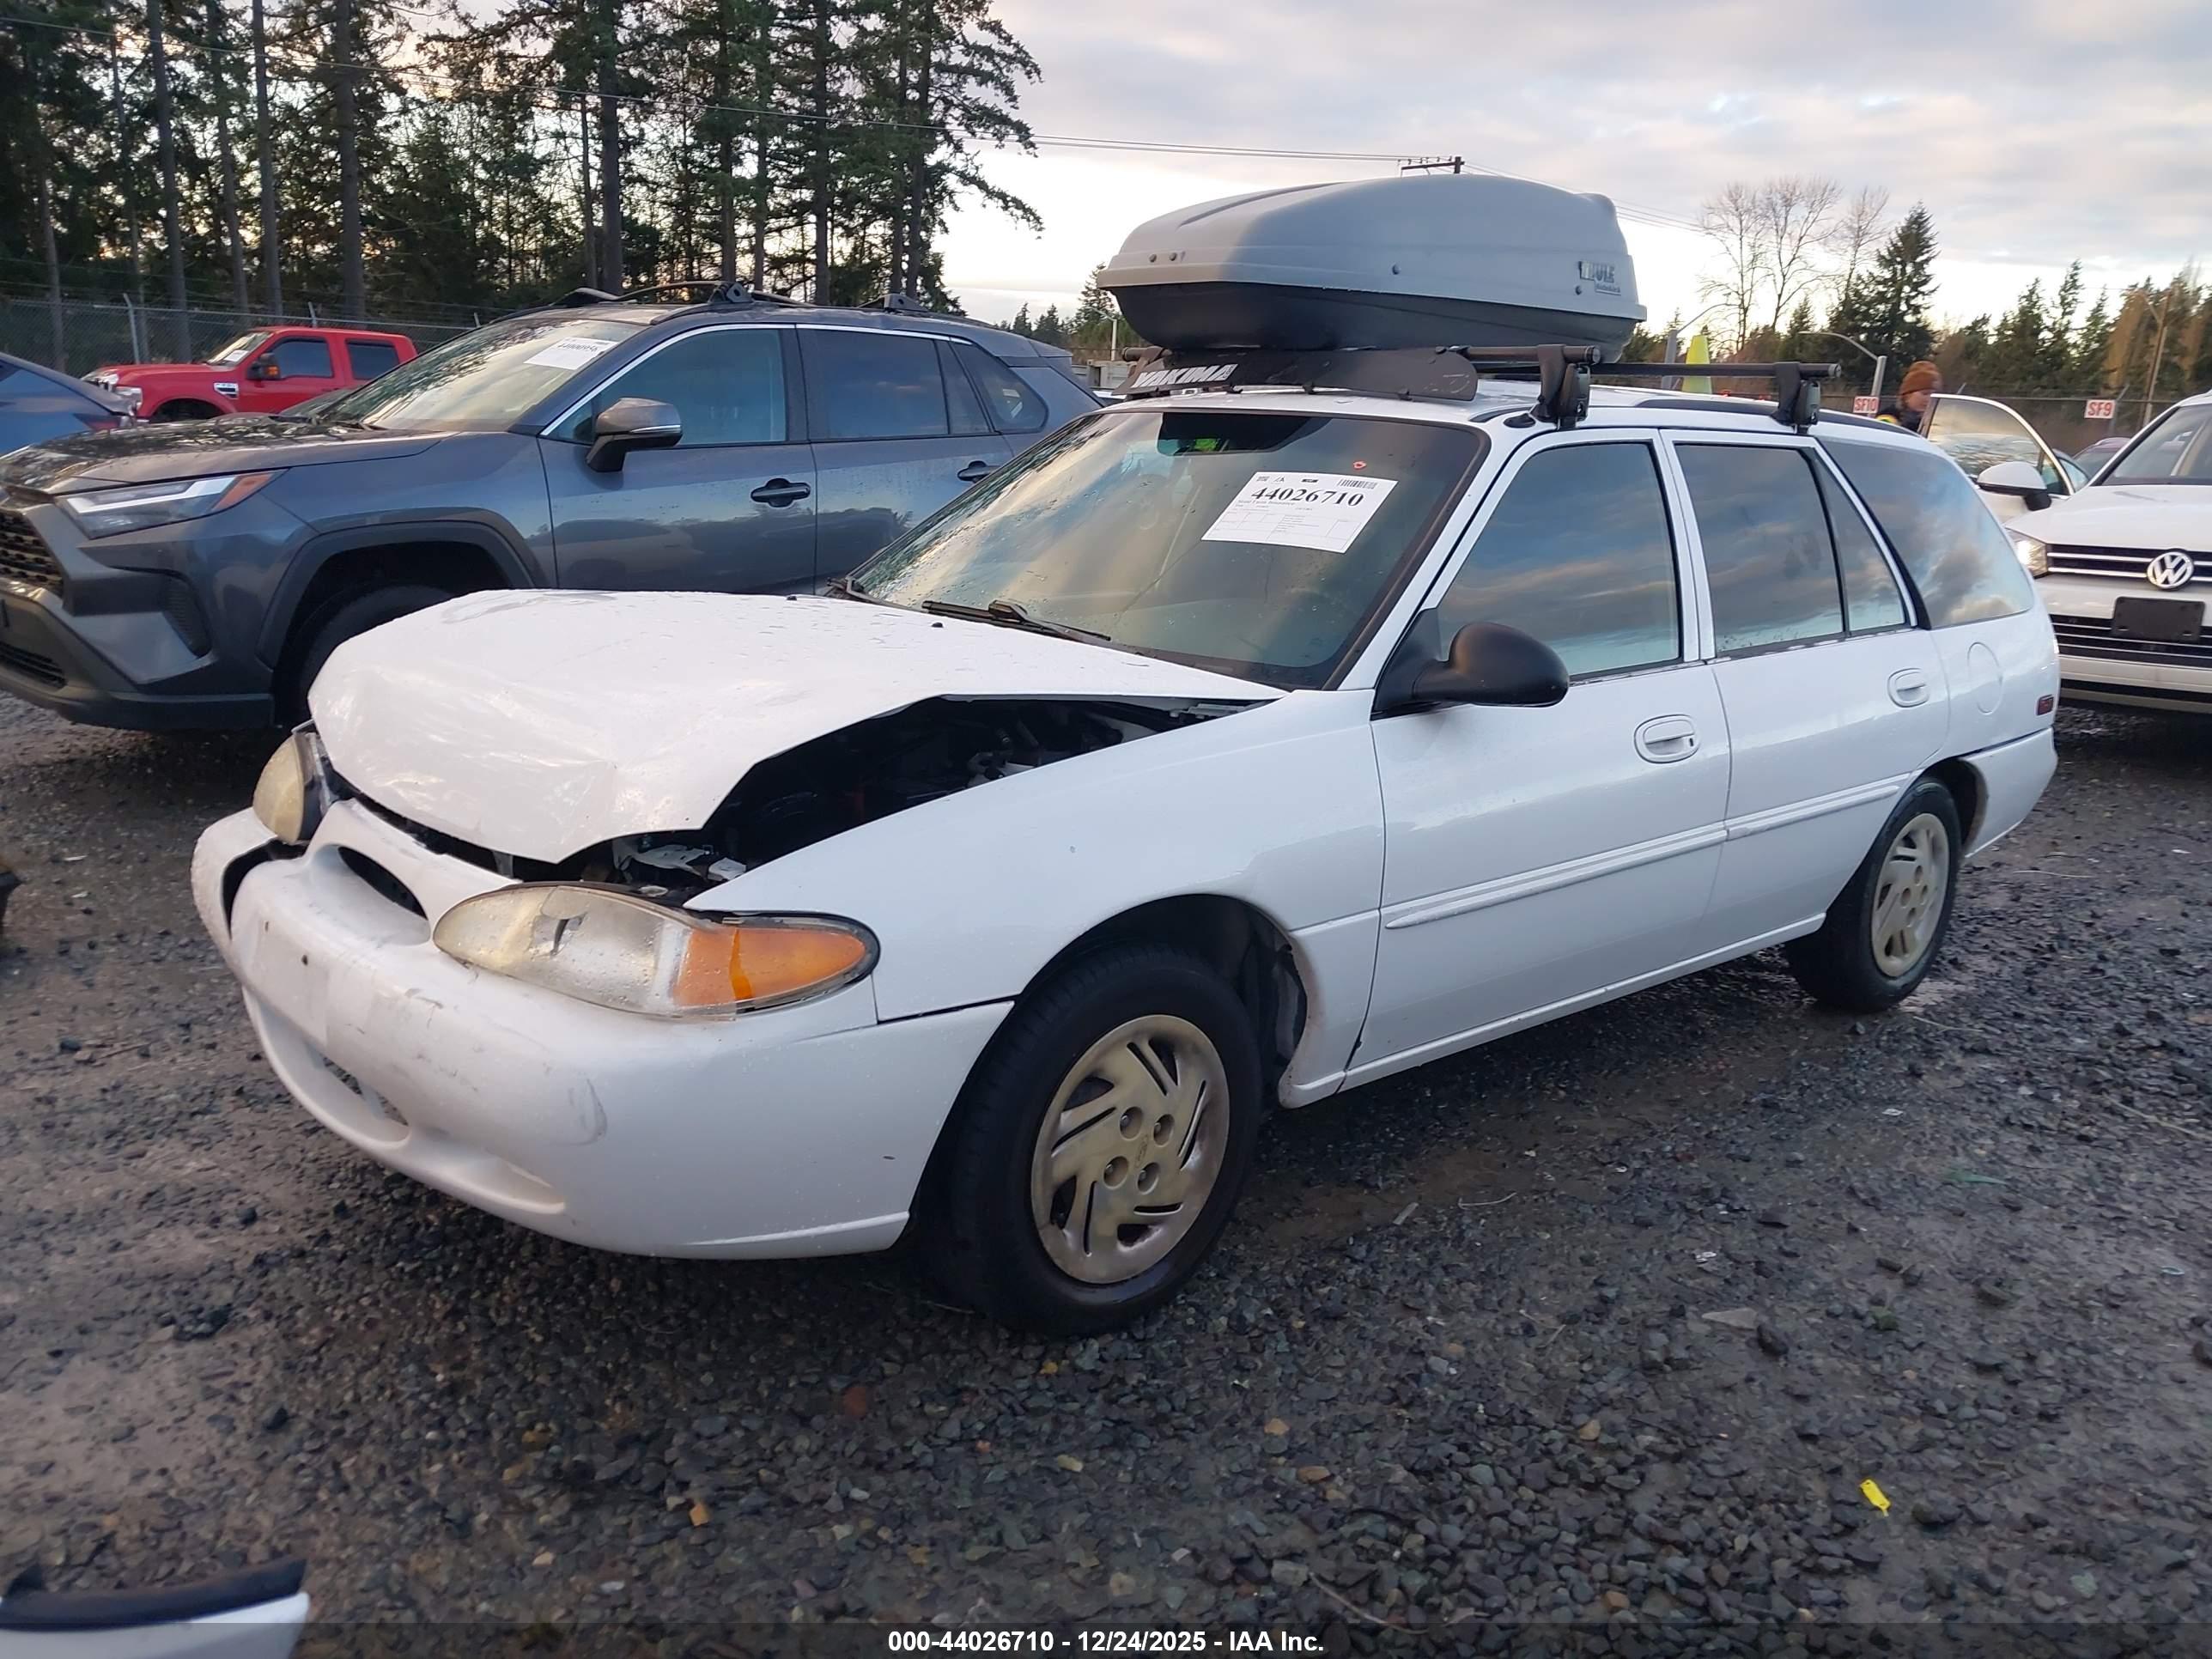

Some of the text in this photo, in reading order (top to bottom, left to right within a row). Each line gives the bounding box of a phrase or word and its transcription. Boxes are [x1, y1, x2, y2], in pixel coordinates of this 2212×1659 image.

[1130, 364, 1237, 388] YAKIMA
[1855, 398, 1877, 411] SF10
[2088, 402, 2112, 416] SF9
[1251, 487, 1364, 507] 44026710
